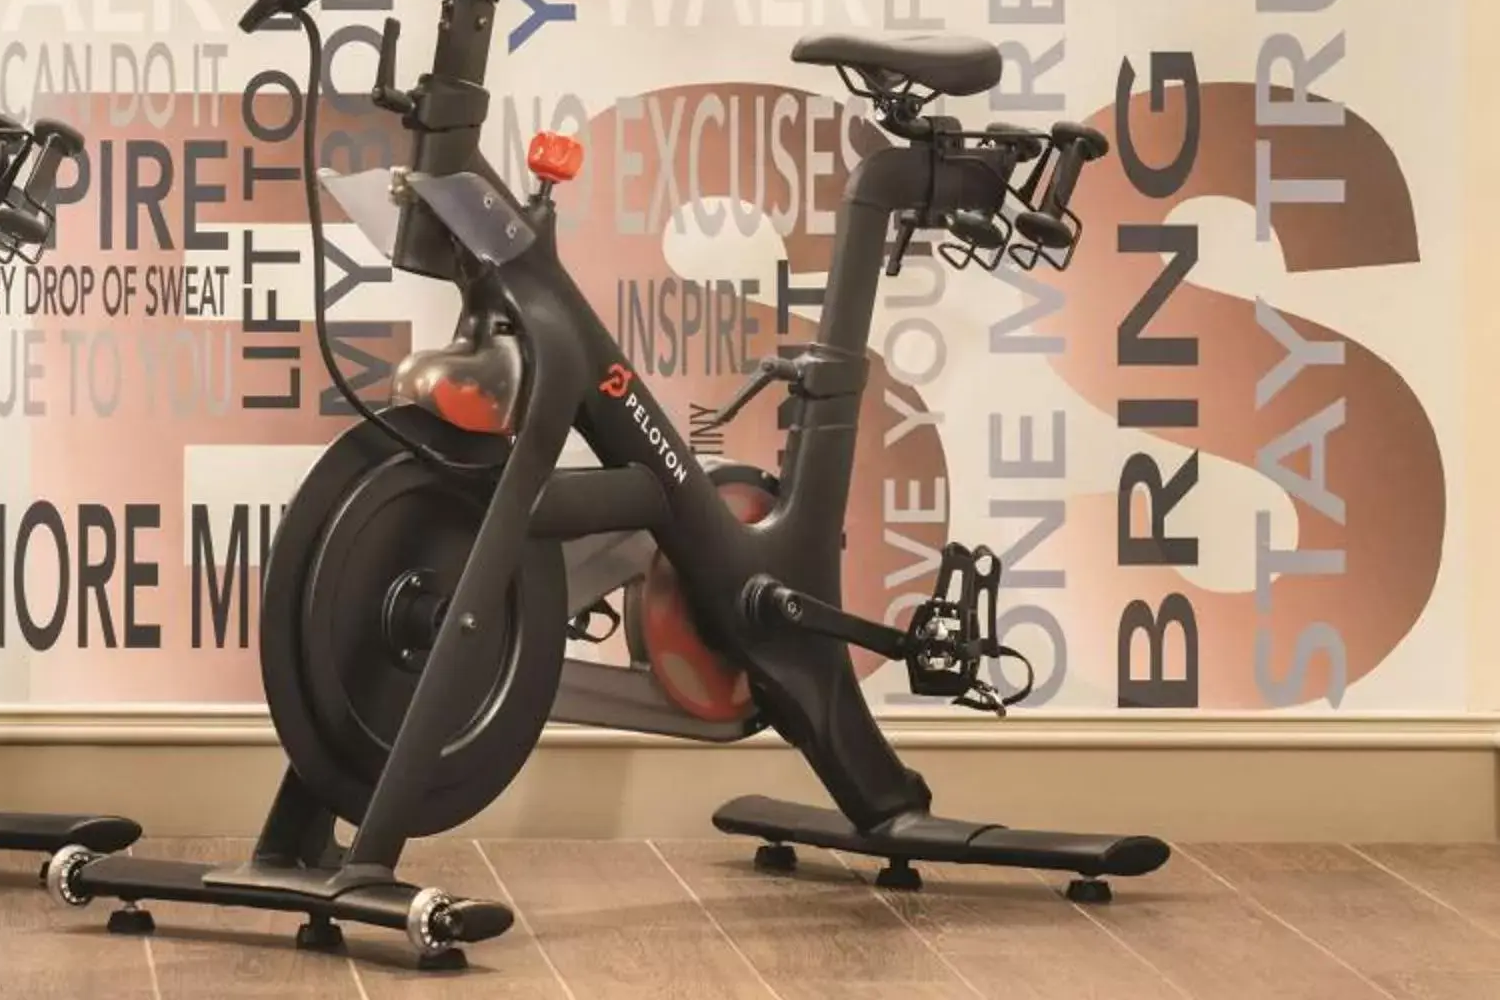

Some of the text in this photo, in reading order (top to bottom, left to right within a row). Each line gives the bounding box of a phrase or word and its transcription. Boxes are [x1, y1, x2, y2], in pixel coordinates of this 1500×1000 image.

[0, 41, 93, 128] CAN
[110, 42, 179, 129] DO
[192, 43, 229, 127] IT
[241, 69, 303, 200] TO
[53, 139, 230, 251] PIRE
[25, 265, 95, 316] DROP
[102, 265, 138, 316] OF
[145, 265, 230, 316] SWEAT
[242, 230, 302, 409] LIFT
[617, 278, 761, 377] INSPIRE
[61, 329, 123, 420] TO
[136, 329, 235, 419] YOU
[1116, 50, 1200, 709] BRING
[625, 392, 687, 484] PELOTON
[1254, 294, 1347, 710] STAY
